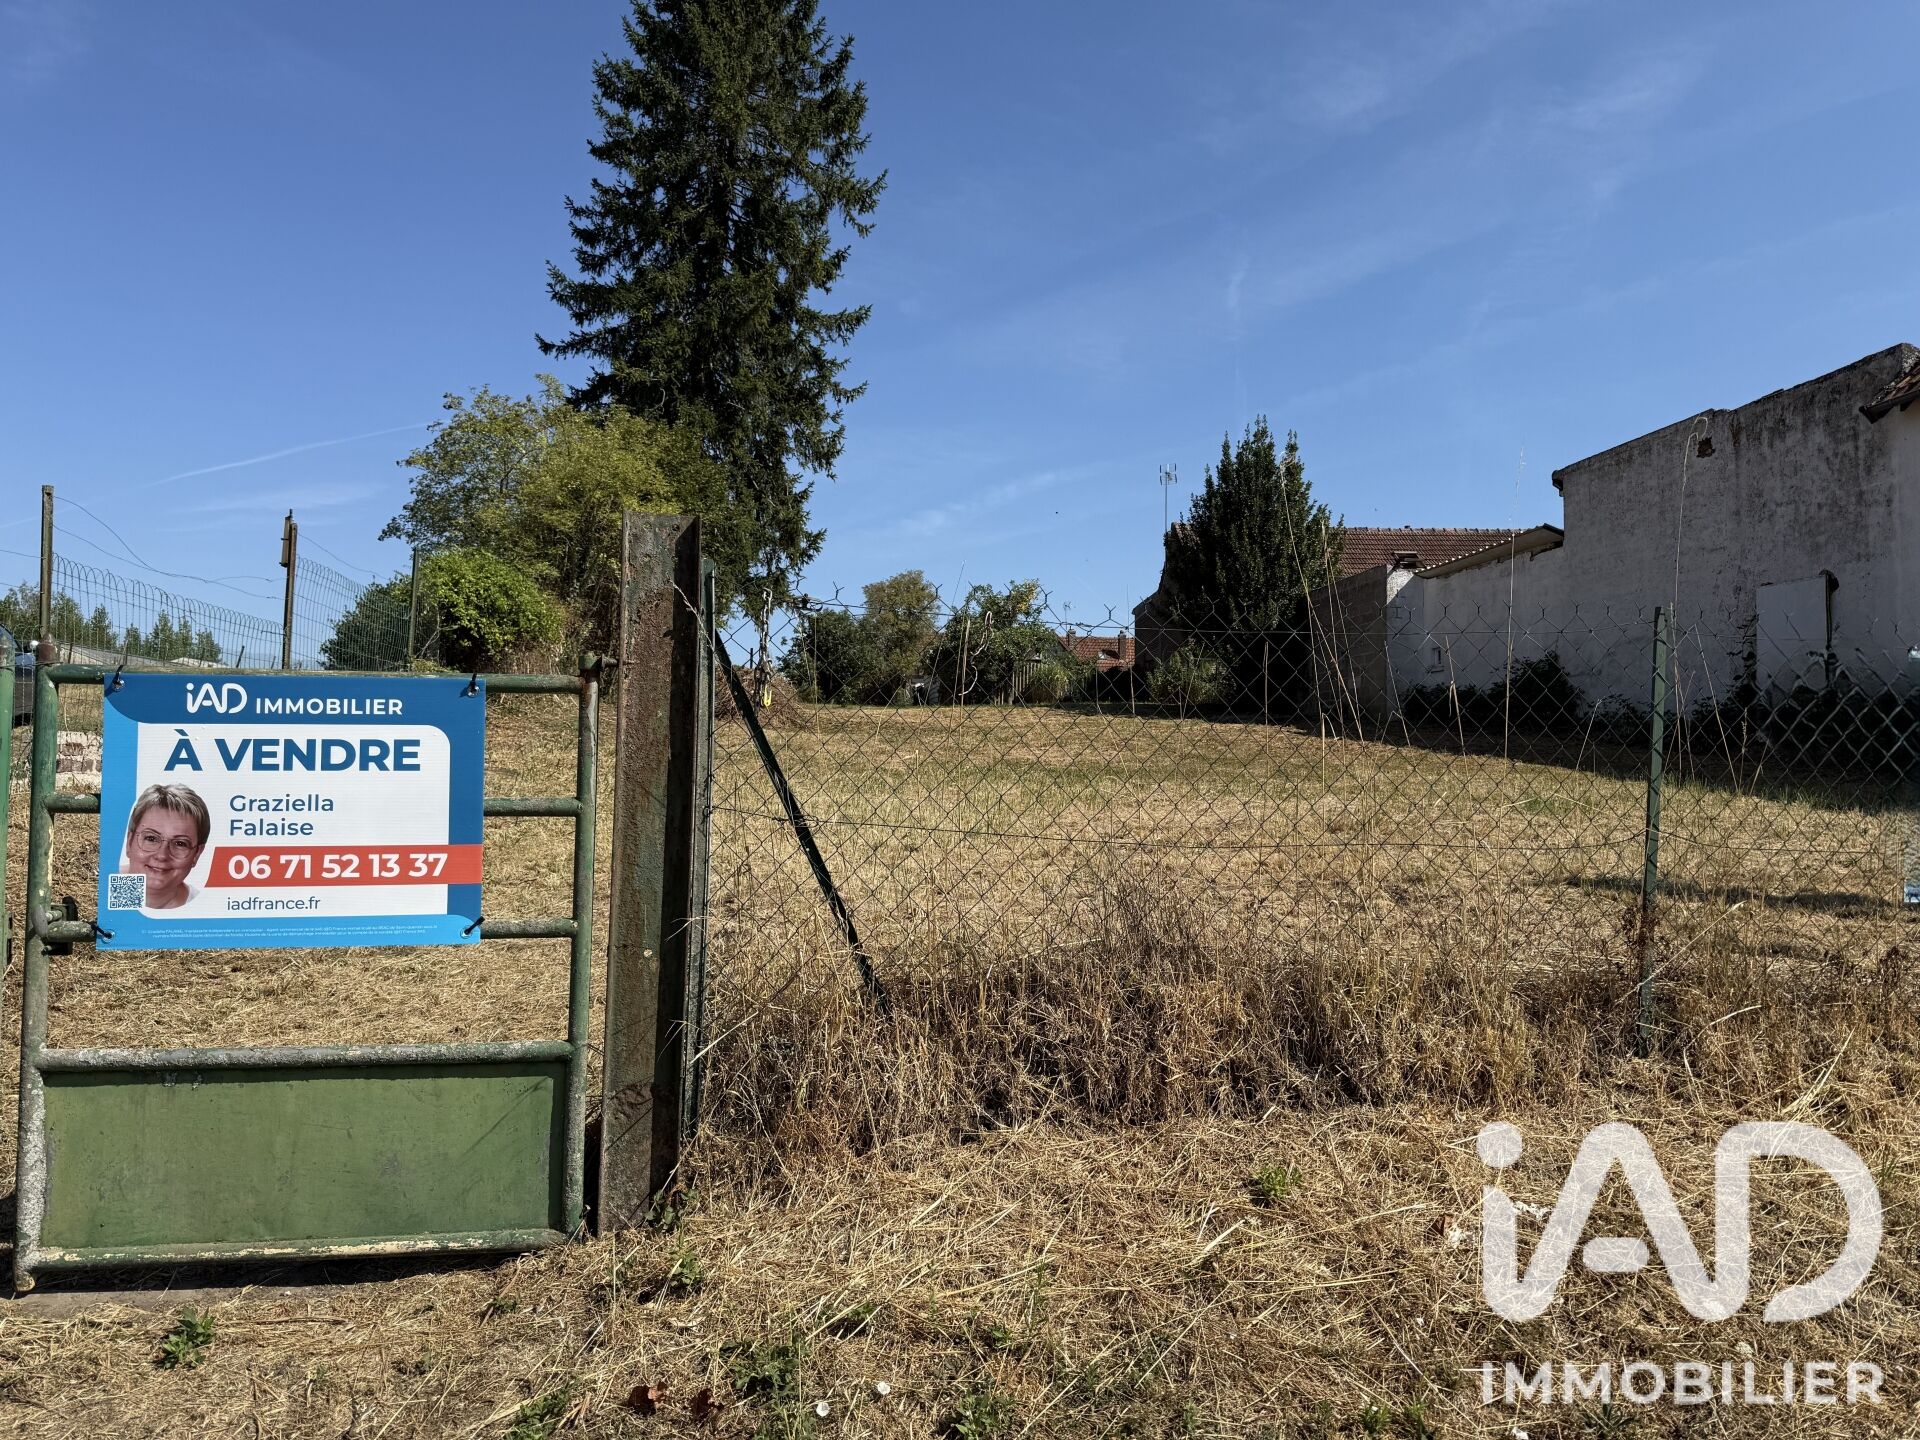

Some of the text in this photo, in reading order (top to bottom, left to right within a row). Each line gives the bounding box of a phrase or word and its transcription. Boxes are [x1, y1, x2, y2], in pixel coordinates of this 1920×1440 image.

[256, 697, 403, 716] IMMOBILIER
[164, 729, 421, 772] À VENDRE
[229, 794, 335, 812] Graziella
[229, 818, 314, 836] Falaise
[228, 852, 448, 880] 06 71 52 13 37
[226, 896, 321, 911] iadfrance.fr
